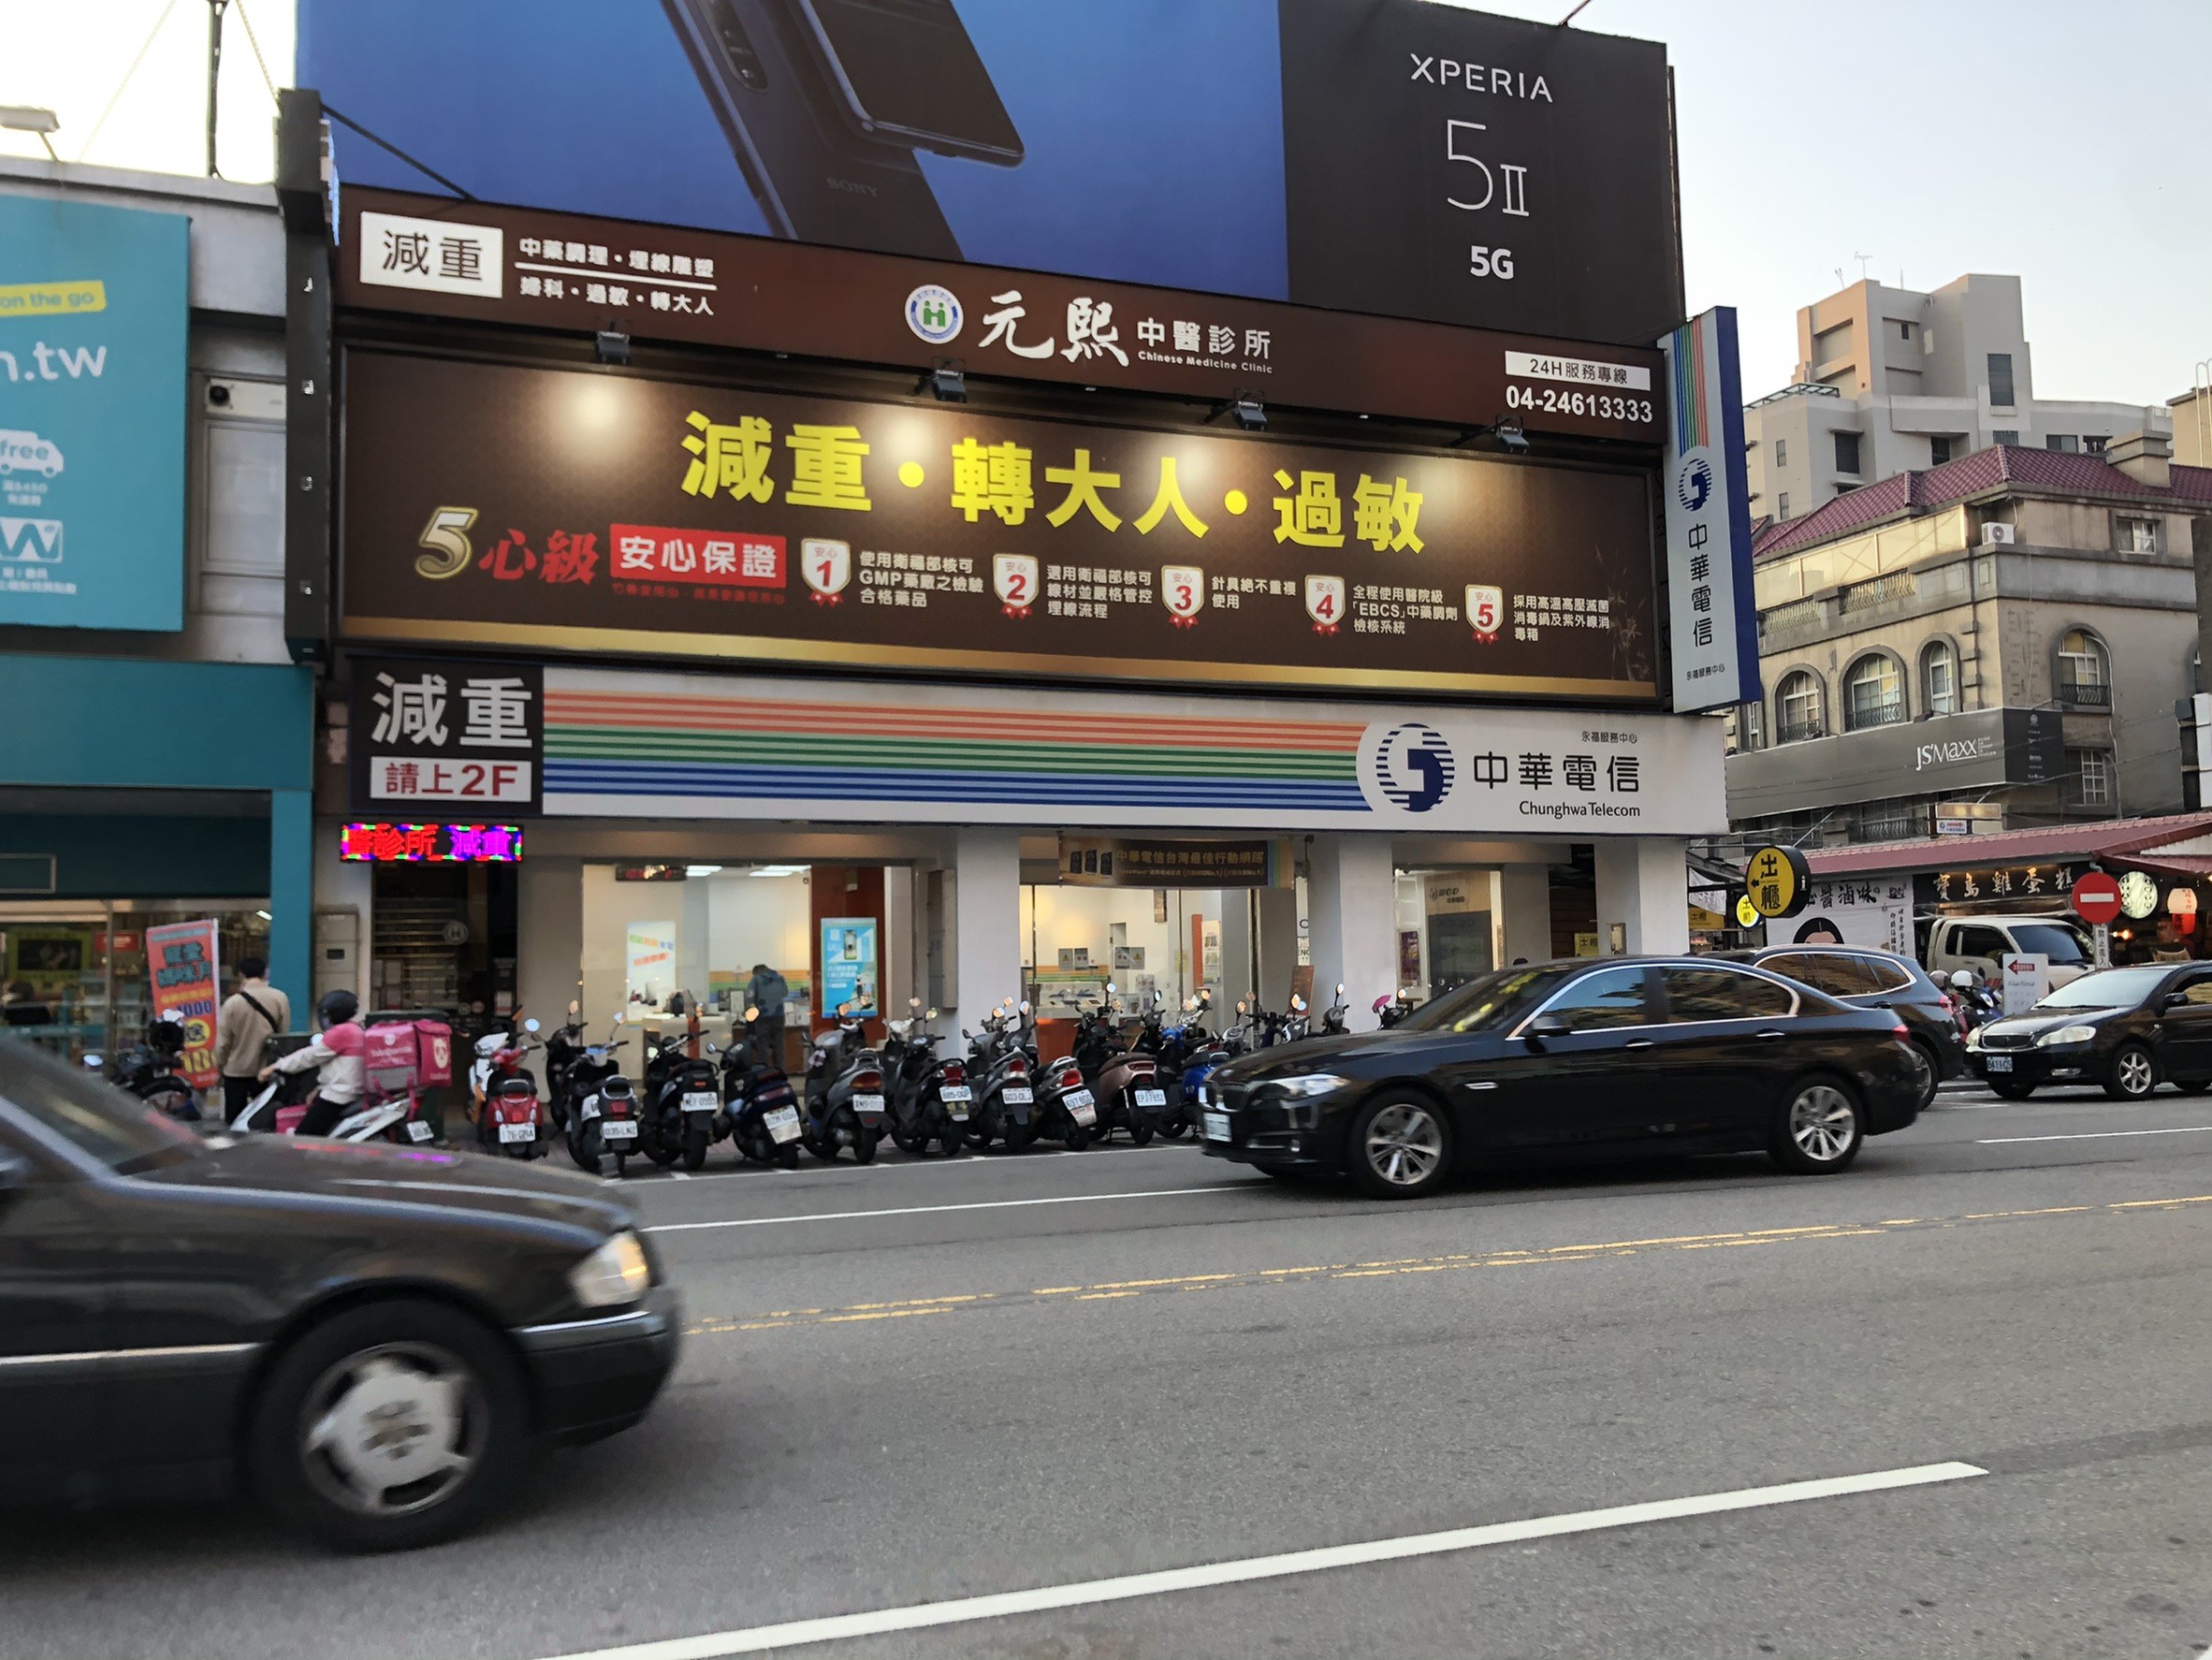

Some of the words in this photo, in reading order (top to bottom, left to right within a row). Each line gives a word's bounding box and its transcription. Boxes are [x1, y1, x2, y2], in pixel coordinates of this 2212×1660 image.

[1410, 53, 1553, 103] XPERIA
[825, 177, 878, 197] SONY
[382, 229, 484, 281] 減重
[1470, 246, 1514, 280] 5G
[1137, 317, 1272, 360] 中醫診所
[1138, 351, 1184, 364] Chinese
[1186, 356, 1237, 370] Medicine
[1241, 362, 1273, 373] Clinic
[1506, 385, 1653, 424] 04-24613333
[619, 535, 777, 578] 安心保證
[814, 546, 838, 558] 安心
[817, 561, 832, 588] 1
[1688, 523, 1713, 648] 中華電信
[860, 588, 927, 607] 合格藥品
[1007, 575, 1026, 601] 2
[1174, 585, 1191, 610] 3
[1212, 593, 1240, 608] 使用
[1047, 601, 1108, 619] 埋線流程
[1316, 594, 1333, 619] 4
[1477, 604, 1493, 627] 5
[371, 672, 533, 749] 減重
[1581, 731, 1637, 745] 永福服務中心
[385, 763, 517, 797] 請上2F
[1474, 751, 1639, 793] 中華電信
[1520, 800, 1587, 820] Chunghwa
[1588, 802, 1640, 817] Telecom
[1761, 853, 1781, 910] 出櫃
